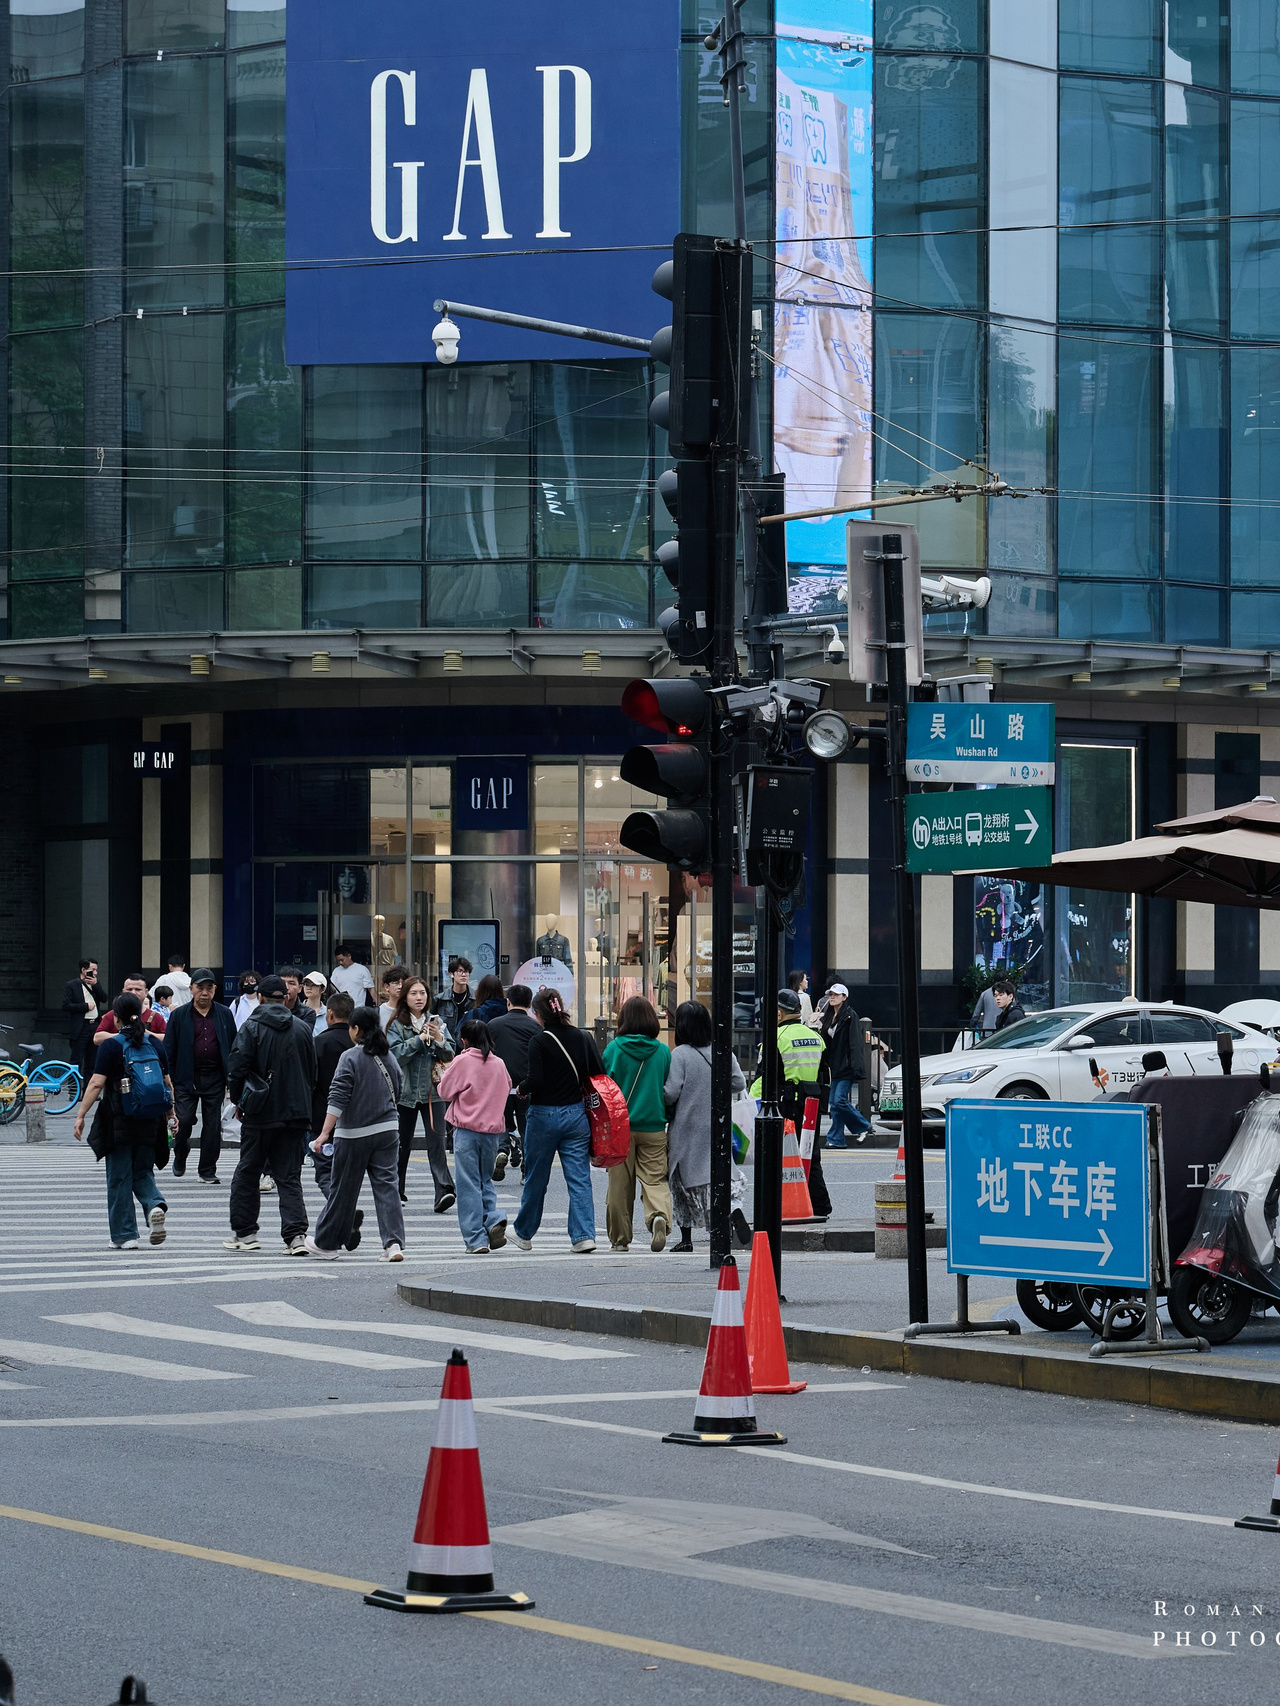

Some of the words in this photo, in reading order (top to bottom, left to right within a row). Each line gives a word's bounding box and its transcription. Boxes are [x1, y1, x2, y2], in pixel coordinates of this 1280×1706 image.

[371, 65, 592, 244] GAP
[930, 712, 1025, 741] 吴山路
[133, 751, 146, 769] GAP
[153, 751, 174, 769] GAP
[955, 746, 986, 757] Wushan
[987, 746, 998, 757] Rd
[934, 765, 940, 776] S
[1010, 766, 1017, 778] N
[471, 777, 513, 810] GAP
[931, 816, 963, 831] A出入口
[983, 812, 1010, 829] 龙翔桥
[931, 832, 963, 846] 地铁1号线
[983, 830, 1010, 843] 公交总站
[1018, 1123, 1073, 1150] 工联CC
[976, 1156, 1117, 1221] 地下车库
